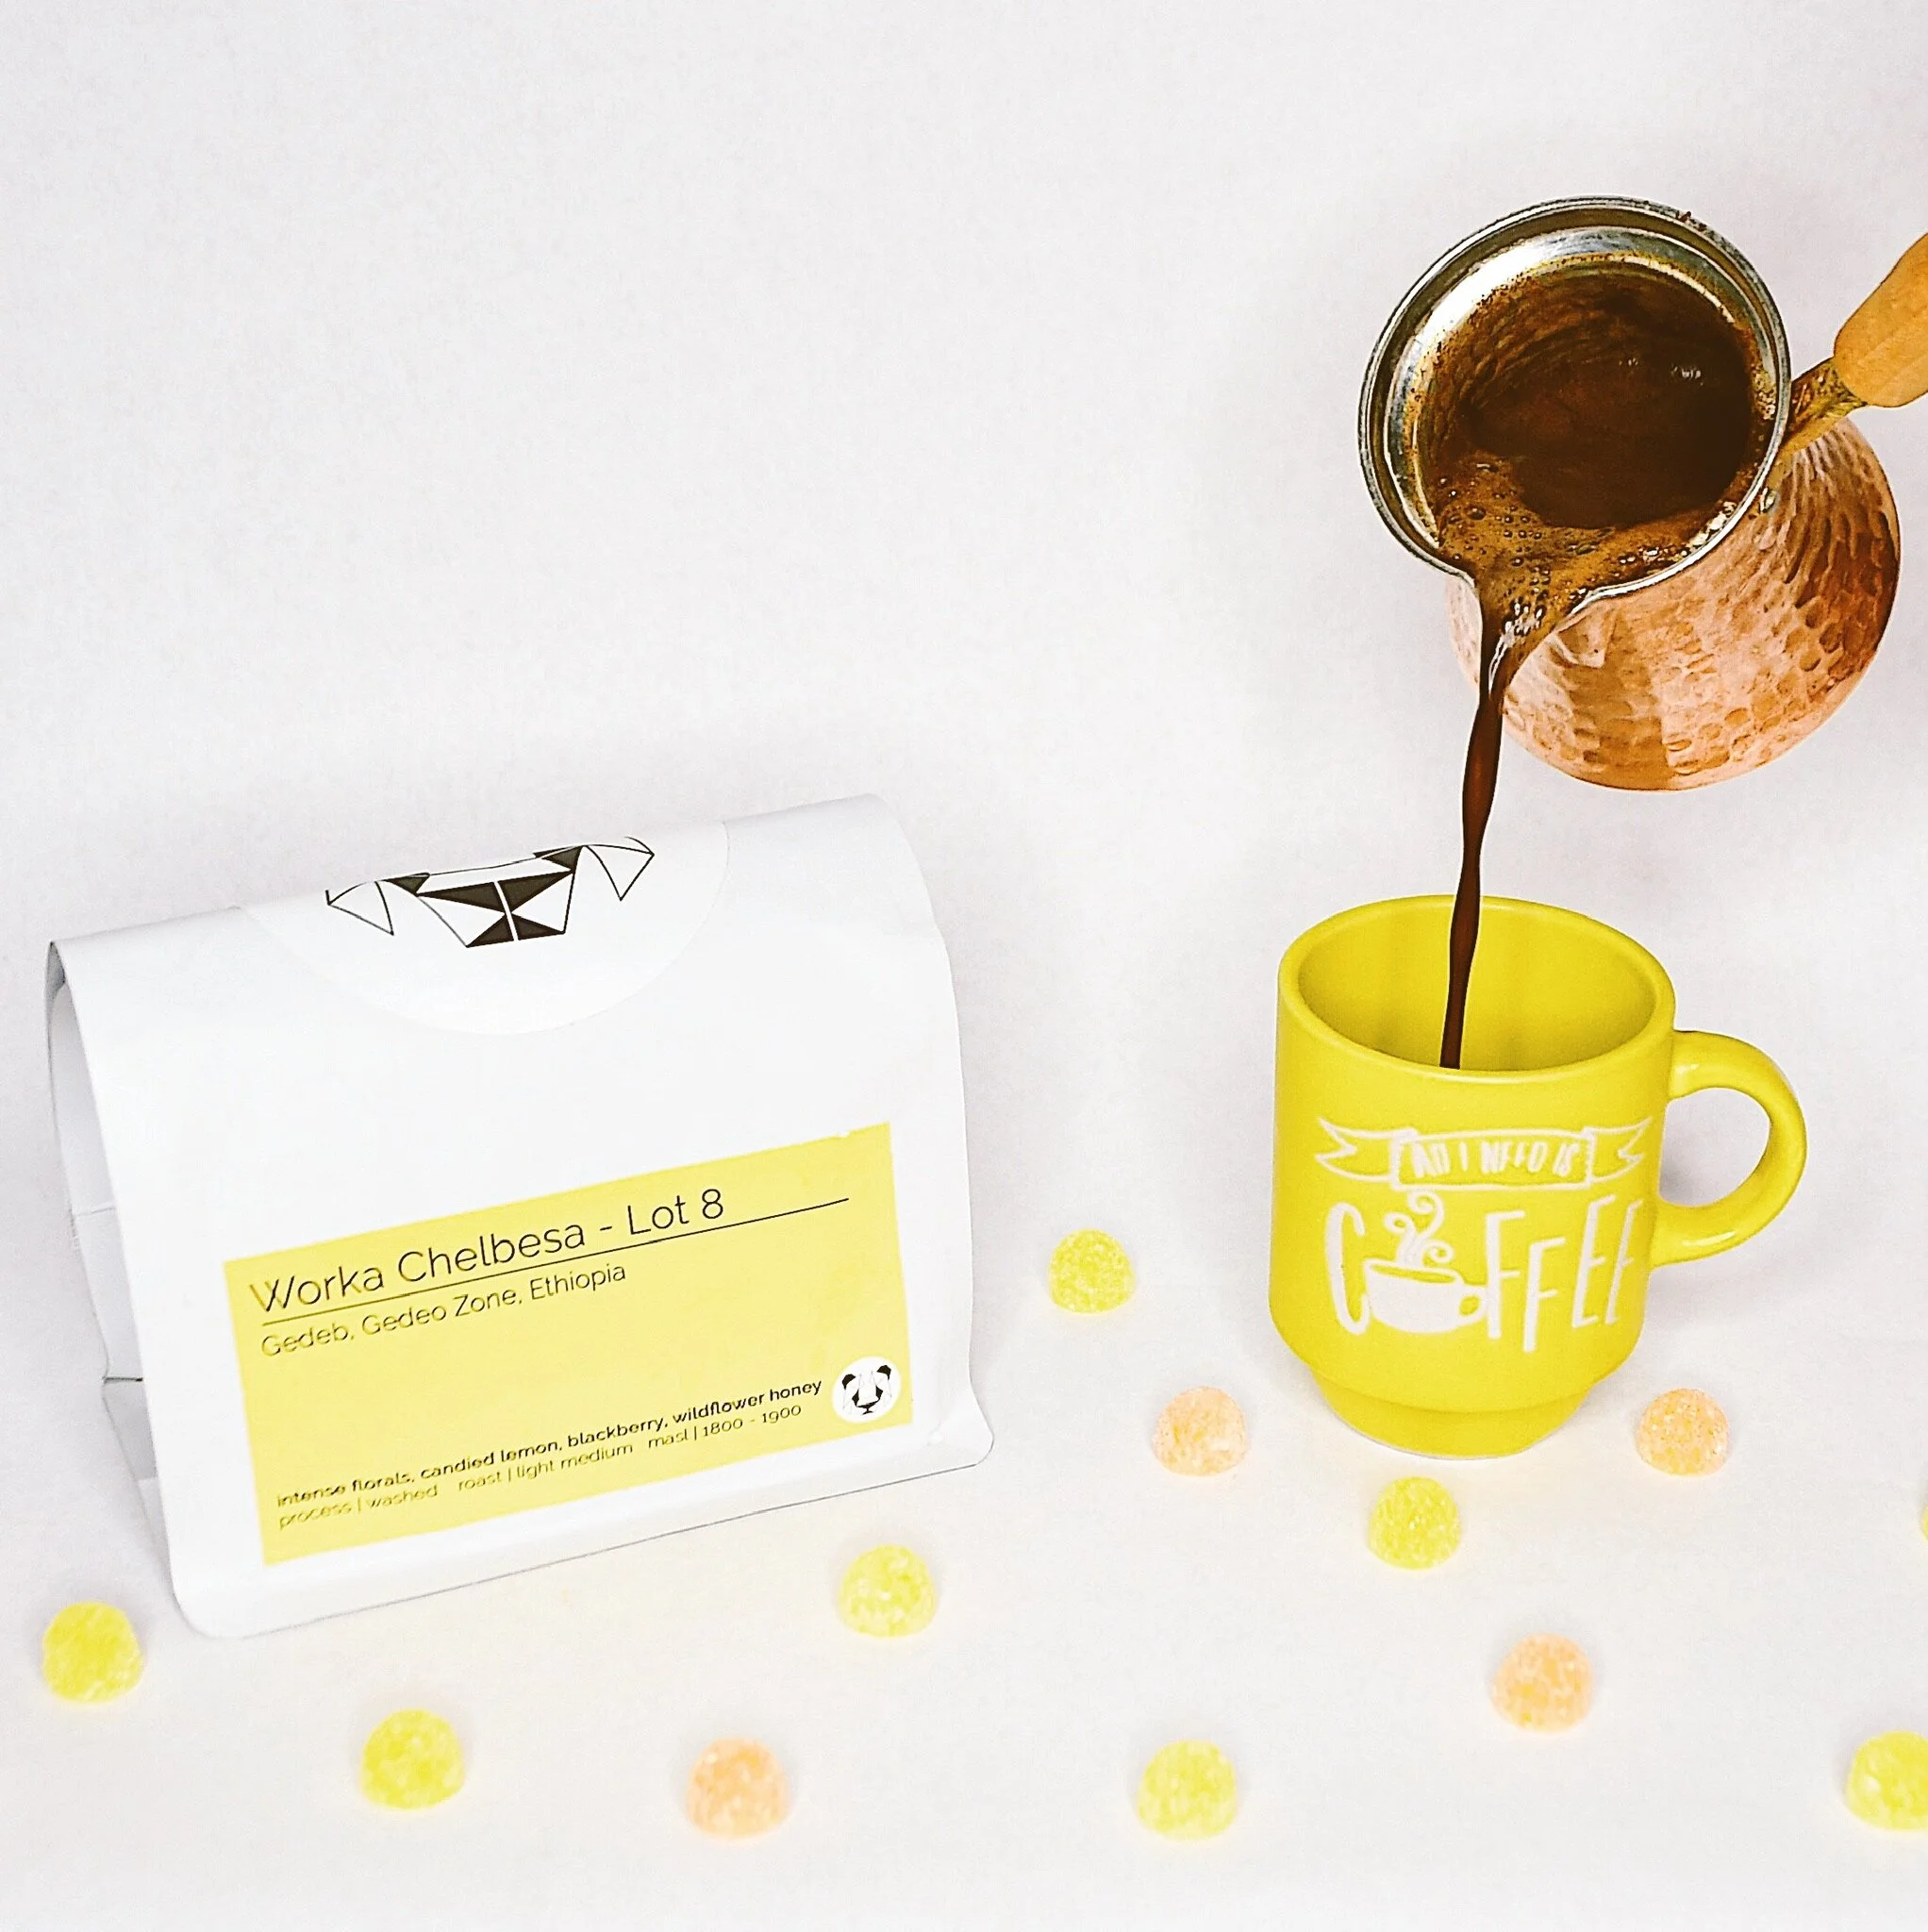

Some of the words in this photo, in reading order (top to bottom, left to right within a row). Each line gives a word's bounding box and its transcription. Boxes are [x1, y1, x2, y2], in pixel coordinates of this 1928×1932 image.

[1459, 1142, 1468, 1171] I
[249, 1266, 384, 1312] Worka
[398, 1224, 585, 1282] Chelbesa
[627, 1195, 690, 1235] Lot
[702, 1189, 723, 1219] 8
[261, 1324, 355, 1357] Gedeb,
[361, 1306, 447, 1335] Gedeo
[453, 1289, 523, 1317] Zone,
[530, 1263, 626, 1300] Ethiopia
[278, 1485, 345, 1507] intense
[352, 1473, 415, 1491] florals,
[421, 1452, 495, 1479] candied
[501, 1441, 562, 1462] lemon,
[567, 1418, 668, 1447] blackberry,
[673, 1393, 765, 1423] wildflower
[770, 1380, 822, 1402] honey
[279, 1500, 352, 1530] process
[366, 1485, 439, 1508] washed
[458, 1472, 502, 1491] roast
[517, 1461, 555, 1479] light
[560, 1443, 633, 1470] medium
[648, 1429, 689, 1449] masl
[704, 1419, 743, 1438] 1800
[762, 1405, 802, 1424] 1900
